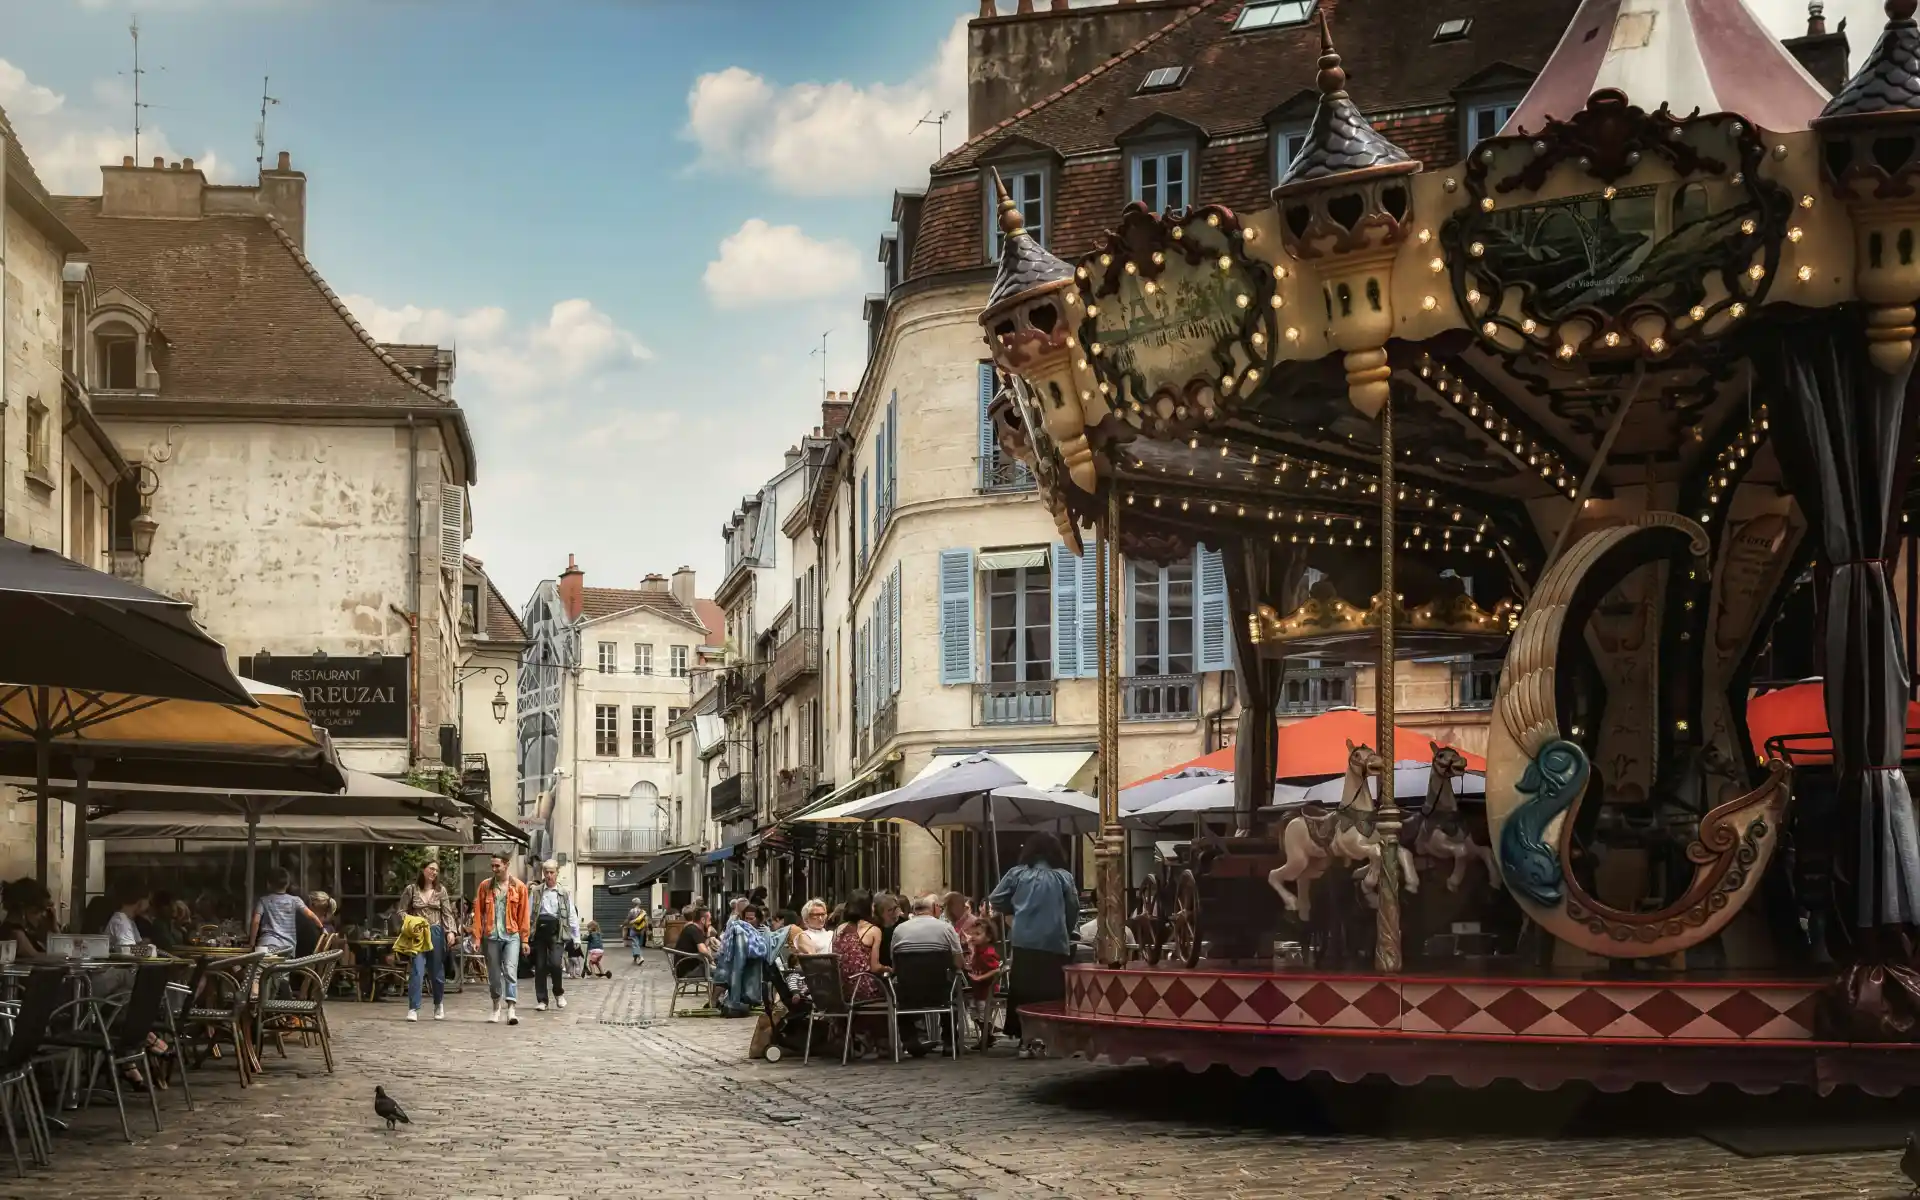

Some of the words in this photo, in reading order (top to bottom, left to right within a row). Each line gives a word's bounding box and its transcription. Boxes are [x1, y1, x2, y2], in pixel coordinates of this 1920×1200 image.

[1579, 278, 1604, 287] Viadu
[291, 669, 361, 681] RESTAURANT
[284, 686, 396, 703] AREUZAI
[347, 709, 361, 717] BAR
[324, 718, 354, 726] GLACIER
